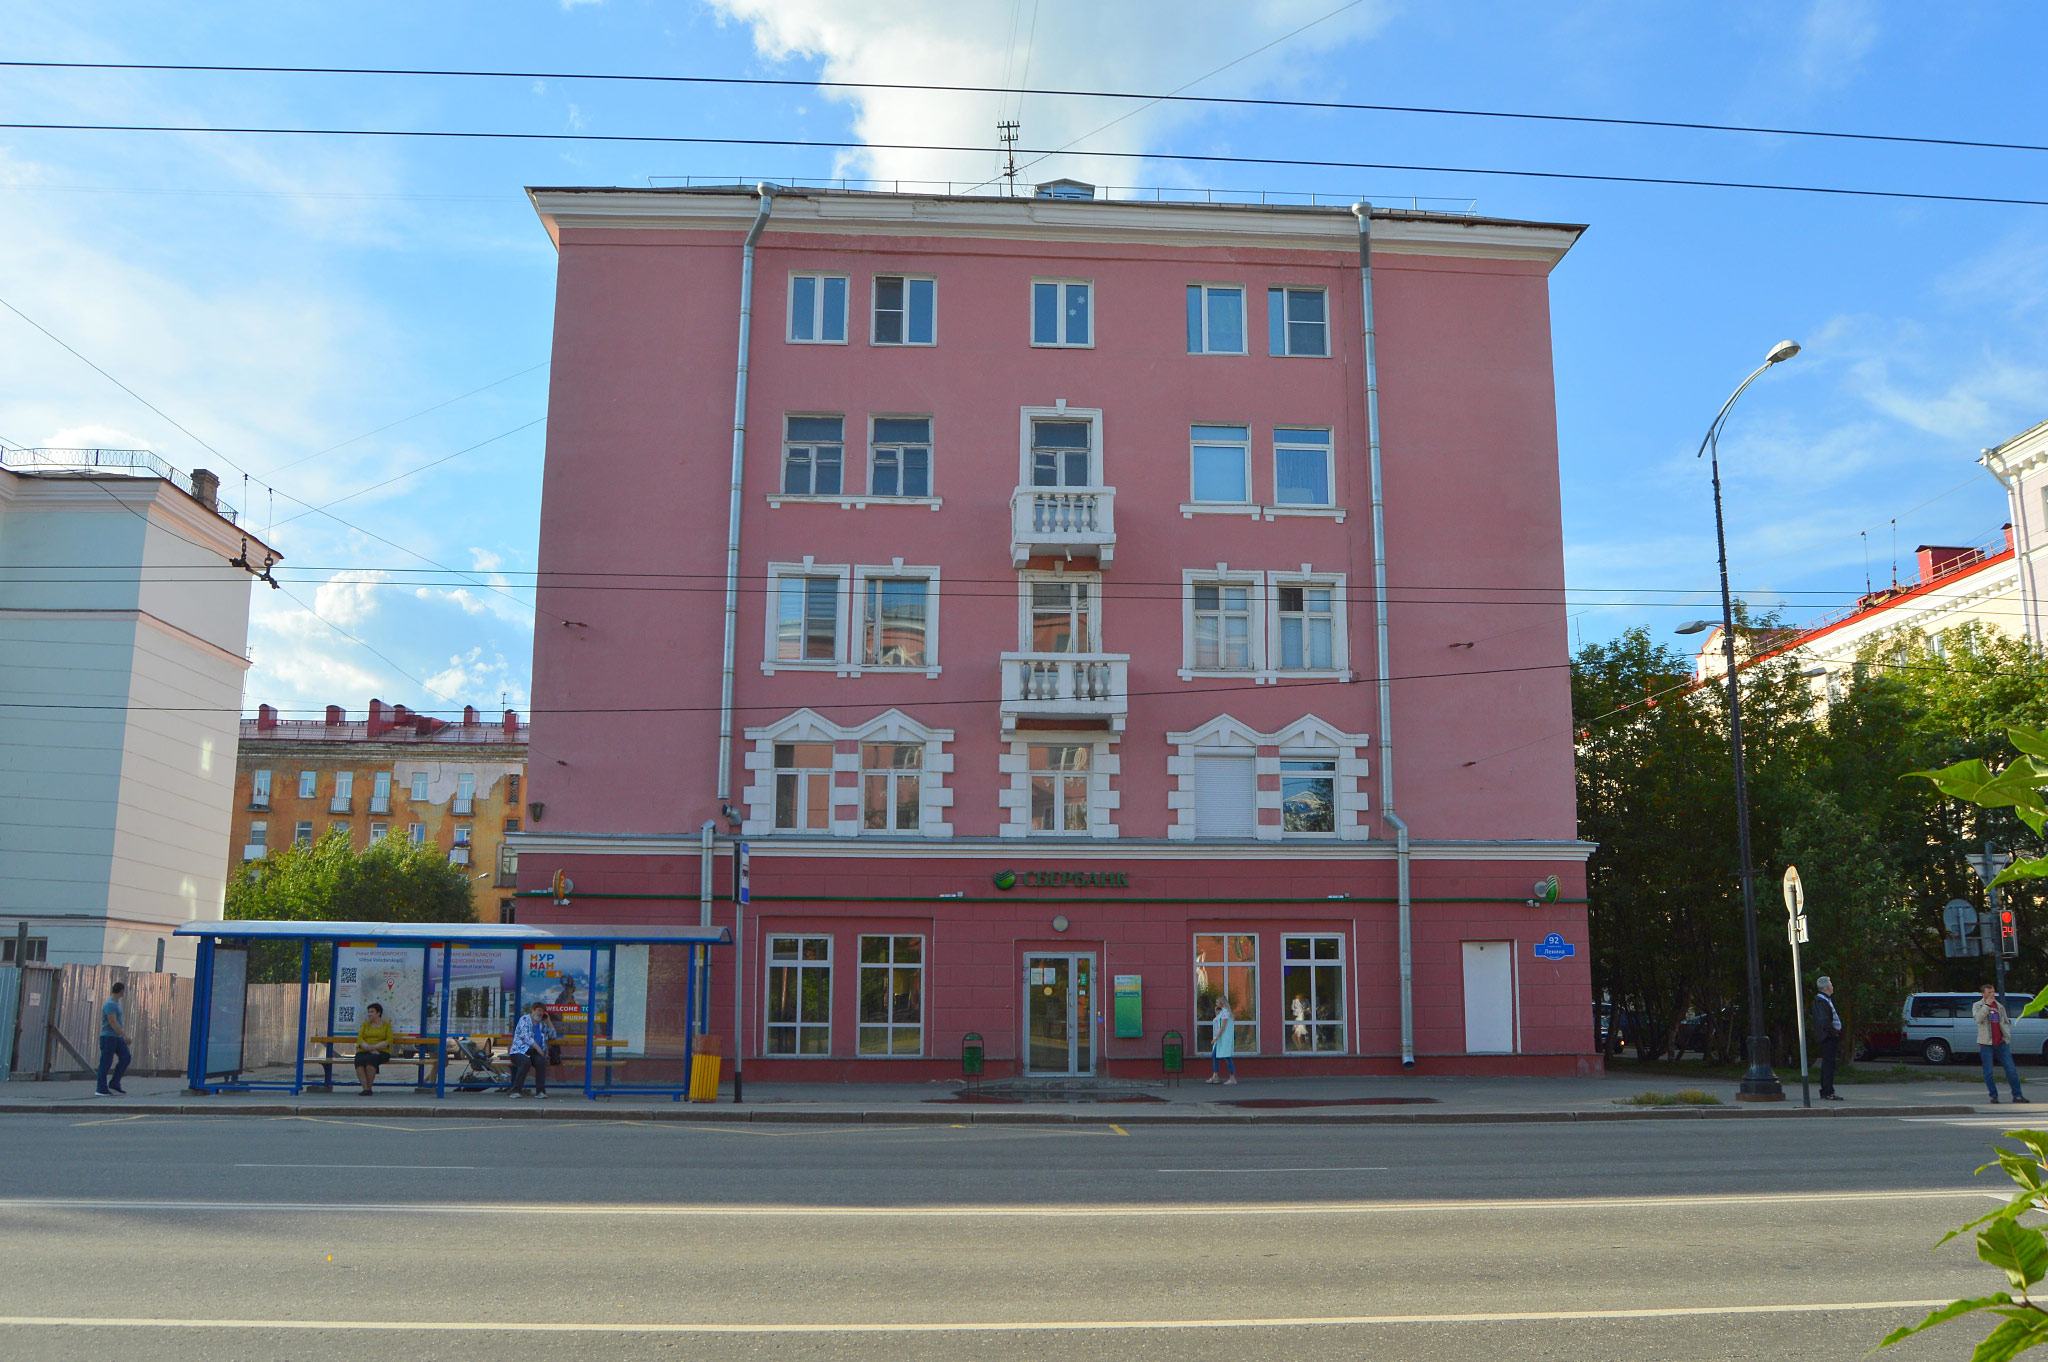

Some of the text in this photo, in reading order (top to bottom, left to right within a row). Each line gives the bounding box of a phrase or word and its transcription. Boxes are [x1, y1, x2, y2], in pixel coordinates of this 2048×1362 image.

[1023, 871, 1129, 888] СБЕРБАНК
[2002, 926, 2013, 938] 24
[530, 970, 545, 978] СК
